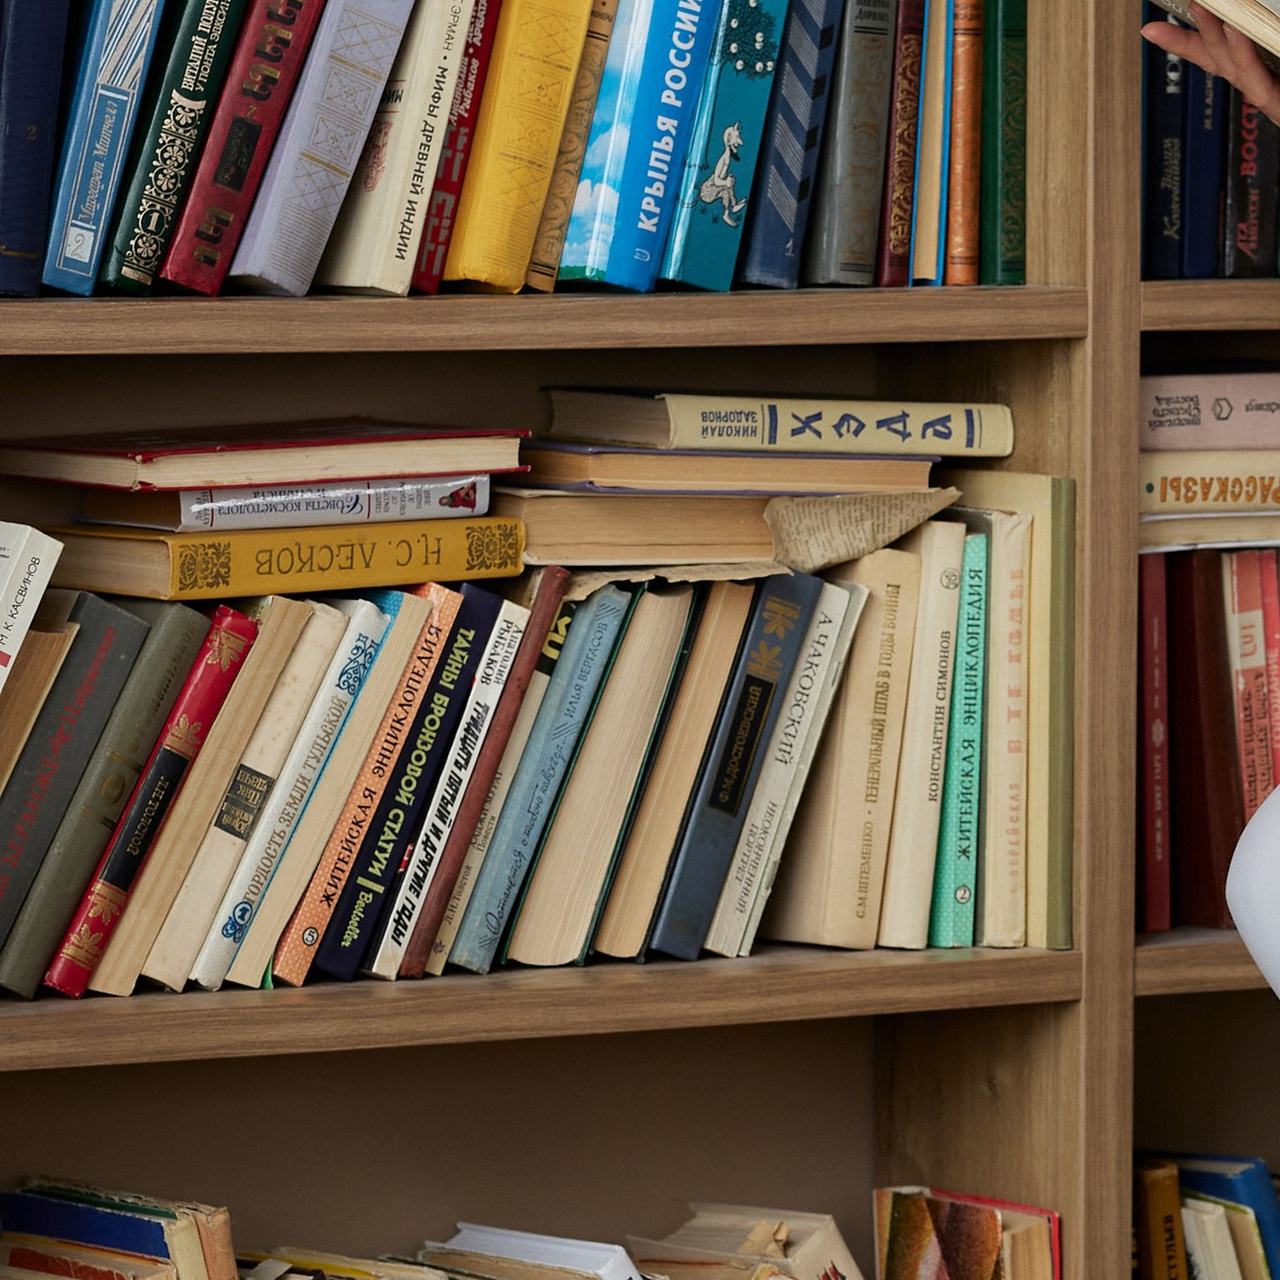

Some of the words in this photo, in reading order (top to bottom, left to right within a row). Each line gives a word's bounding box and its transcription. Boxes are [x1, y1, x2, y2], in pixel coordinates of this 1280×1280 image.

[441, 4, 462, 51] ЭРМАН
[177, 34, 209, 91] ВИТАЛИЙ
[194, 81, 206, 93] У
[197, 41, 218, 83] ПОНТА
[425, 64, 448, 119] МИФЫ
[456, 56, 482, 118] Рыбаков
[407, 119, 437, 196] ДРЕВНЕЙ
[631, 113, 683, 233] КРЫЛЬЯ
[393, 197, 418, 260] ИНДИИ
[699, 409, 758, 424] ЗАДОРНОВ
[699, 423, 758, 439] НИКОЛАЙ
[216, 500, 302, 519] косметолога
[6, 553, 43, 621] КАСВИНОВ
[252, 535, 378, 579] ЛЕСКОВ
[813, 610, 835, 633] А.
[880, 581, 902, 630] ВОЙНЫ
[436, 624, 479, 692] ТАЙНЫ
[477, 616, 514, 687] РЫБАКОВ
[490, 622, 525, 687] Анатолий
[560, 681, 587, 720] ИЛЬЯ
[574, 620, 611, 683] ВЕРГАСОВ
[877, 630, 897, 667] ГОДЫ
[877, 668, 892, 679] В
[934, 629, 953, 701] СИМОНОВ
[961, 566, 984, 726] ЭНЦИКЛОПЕДИЯ
[772, 630, 829, 768] ЧАКОВСКИЙ
[871, 679, 891, 716] ШТАБ
[315, 785, 380, 909] ЖИТЕЙСКАЯ
[366, 622, 446, 780] ЭНЦИКЛОПЕДИЯ
[390, 690, 455, 807] БРОНЗОВОЙ
[449, 698, 492, 775] ТРИДЦАТЬ
[860, 716, 888, 804] ГЕНЕРАЛЬНЫЙ
[925, 703, 947, 803] КОНСТАНТИН
[0, 751, 64, 868] БЕРАНЖЕ
[240, 825, 289, 905] ГОРДОСТЬ
[276, 772, 313, 828] ЗЕМЛИ
[299, 692, 350, 774] ТУЛЬСКОЙ
[427, 820, 446, 838] И
[431, 768, 469, 827] ПЯТЫЙ
[953, 737, 977, 861] ЖИТЕЙСКАЯ
[365, 805, 409, 878] СТАТУИ
[475, 812, 497, 853] Повести
[731, 821, 760, 886] ПОРТРЕТ
[732, 798, 779, 916] НЕОКОНЧЕННЫЙ
[403, 833, 441, 897] ДРУГИЕ
[337, 887, 375, 951] Bestseller
[386, 894, 418, 947] ГОДЫ
